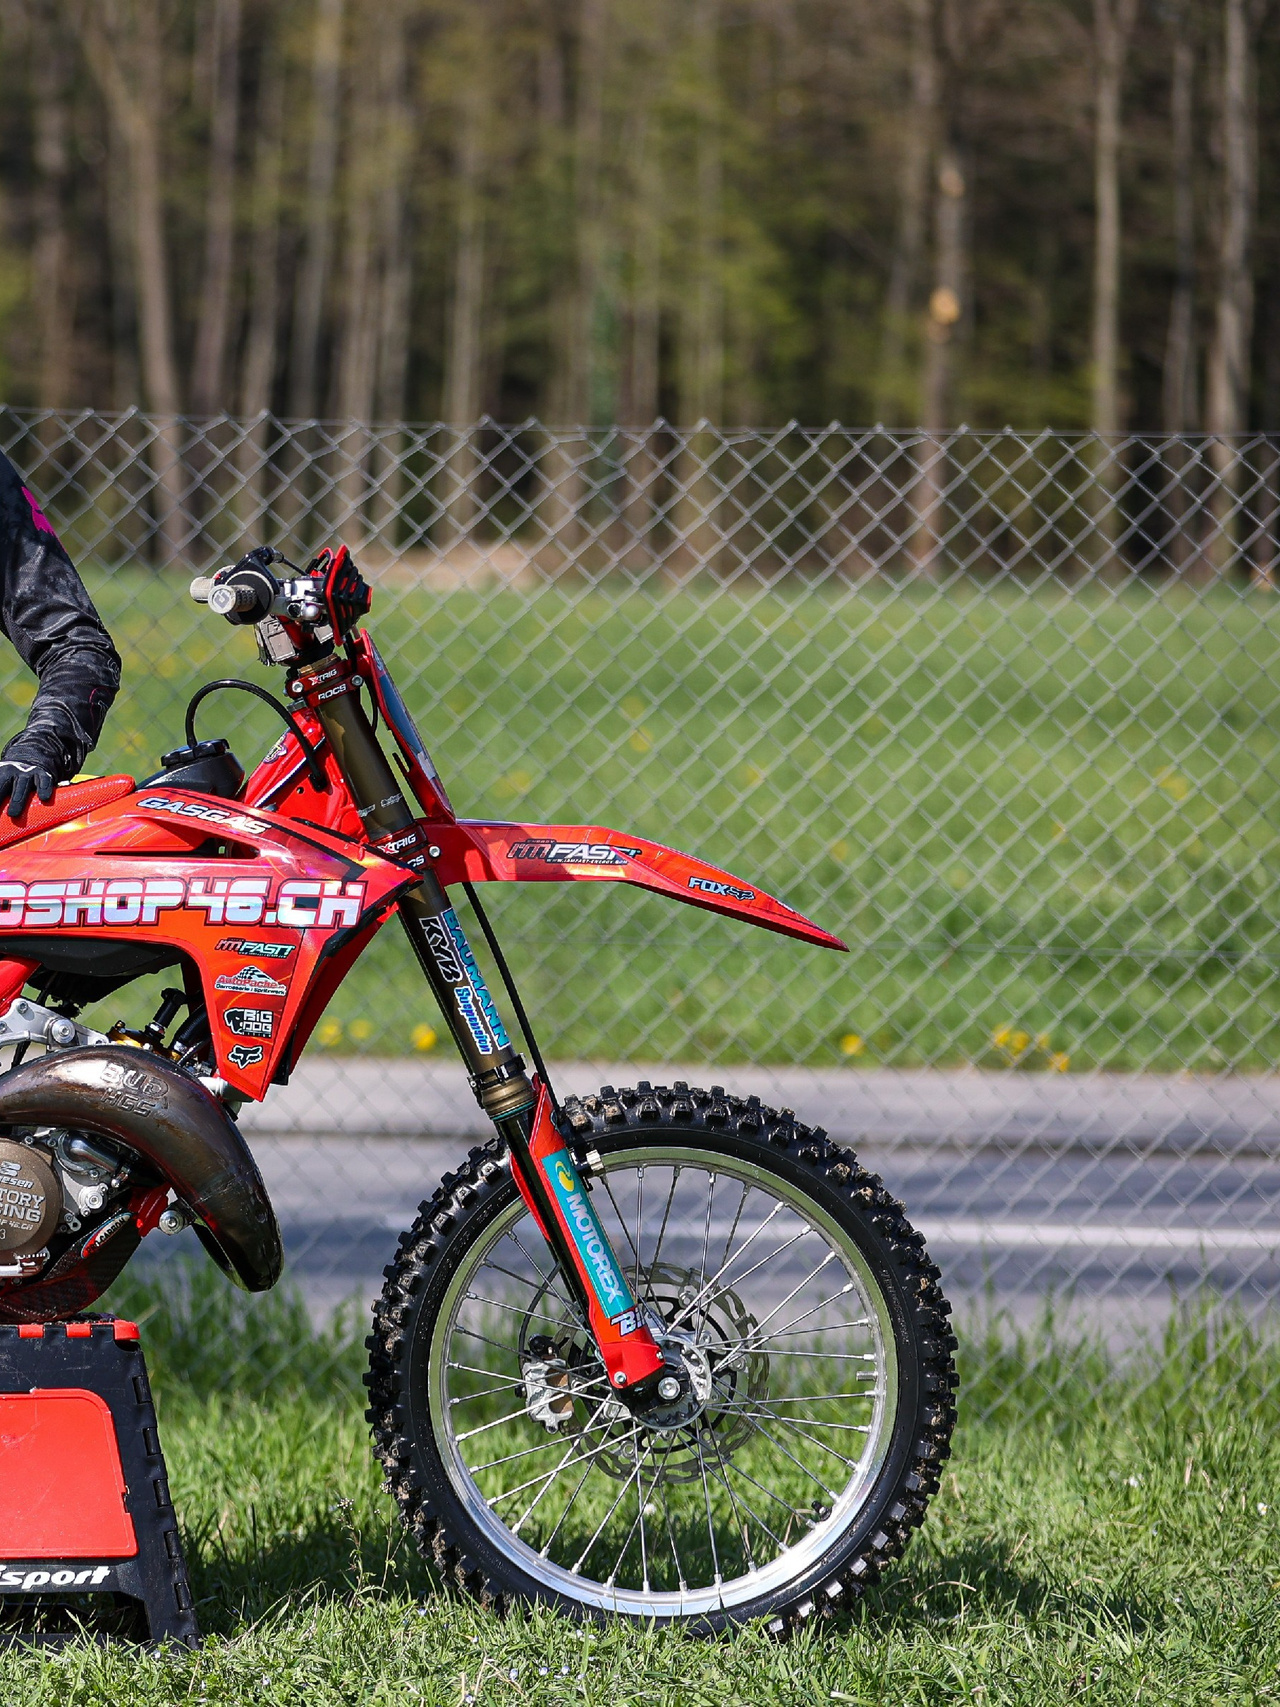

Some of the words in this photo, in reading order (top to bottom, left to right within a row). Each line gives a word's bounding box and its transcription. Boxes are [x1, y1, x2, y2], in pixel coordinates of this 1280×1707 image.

[318, 683, 347, 700] ROCS
[136, 797, 272, 834] GASGAS
[688, 877, 728, 896] FOX
[441, 908, 511, 1050] BAUMANN
[100, 1063, 169, 1099] BUD
[566, 1193, 624, 1303] MOTOREX
